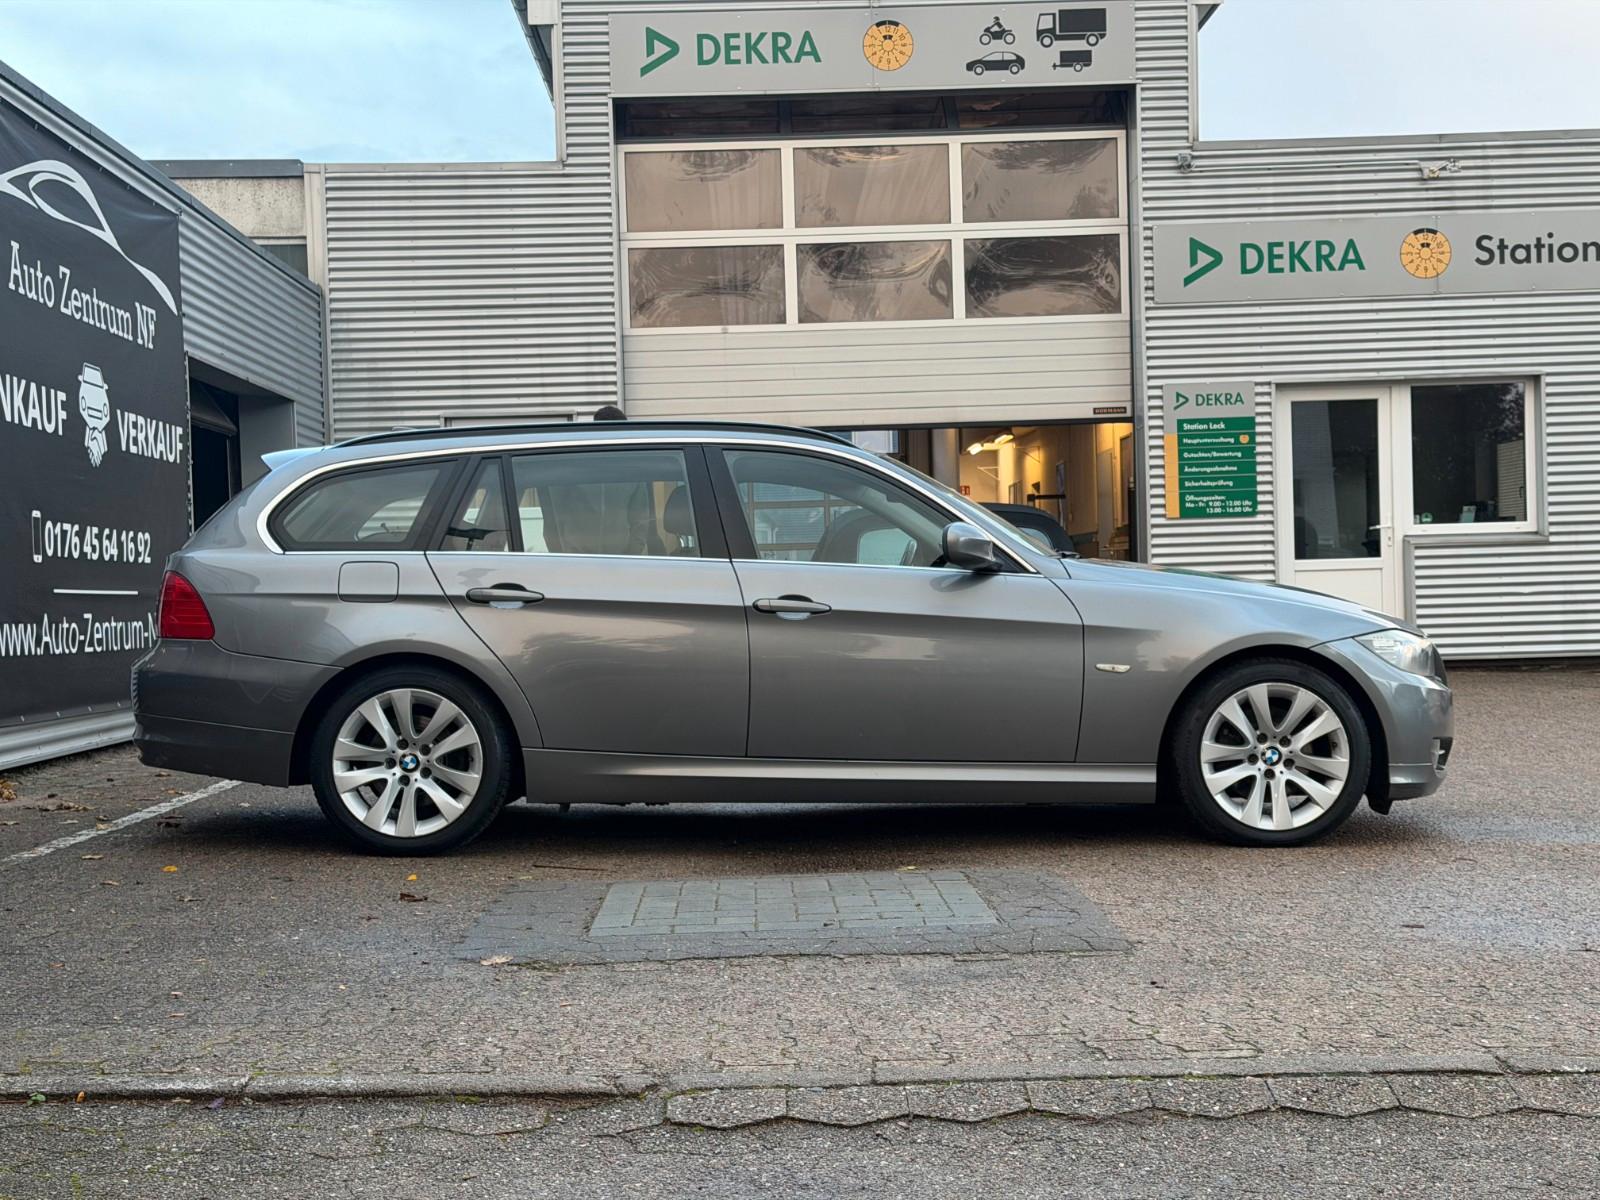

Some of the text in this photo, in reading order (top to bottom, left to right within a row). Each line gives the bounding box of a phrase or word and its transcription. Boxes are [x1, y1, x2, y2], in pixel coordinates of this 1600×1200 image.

[696, 30, 822, 65] DEKRA
[1240, 238, 1366, 275] DEKRA
[1475, 232, 1600, 266] Station
[8, 240, 157, 350] Auto Zentrum NF
[0, 373, 68, 437] NKAUF
[1195, 392, 1245, 406] DEKRA
[116, 409, 184, 464] VERKAUF
[1183, 422, 1208, 431] Station
[44, 520, 152, 564] 0176 45 64 16 92
